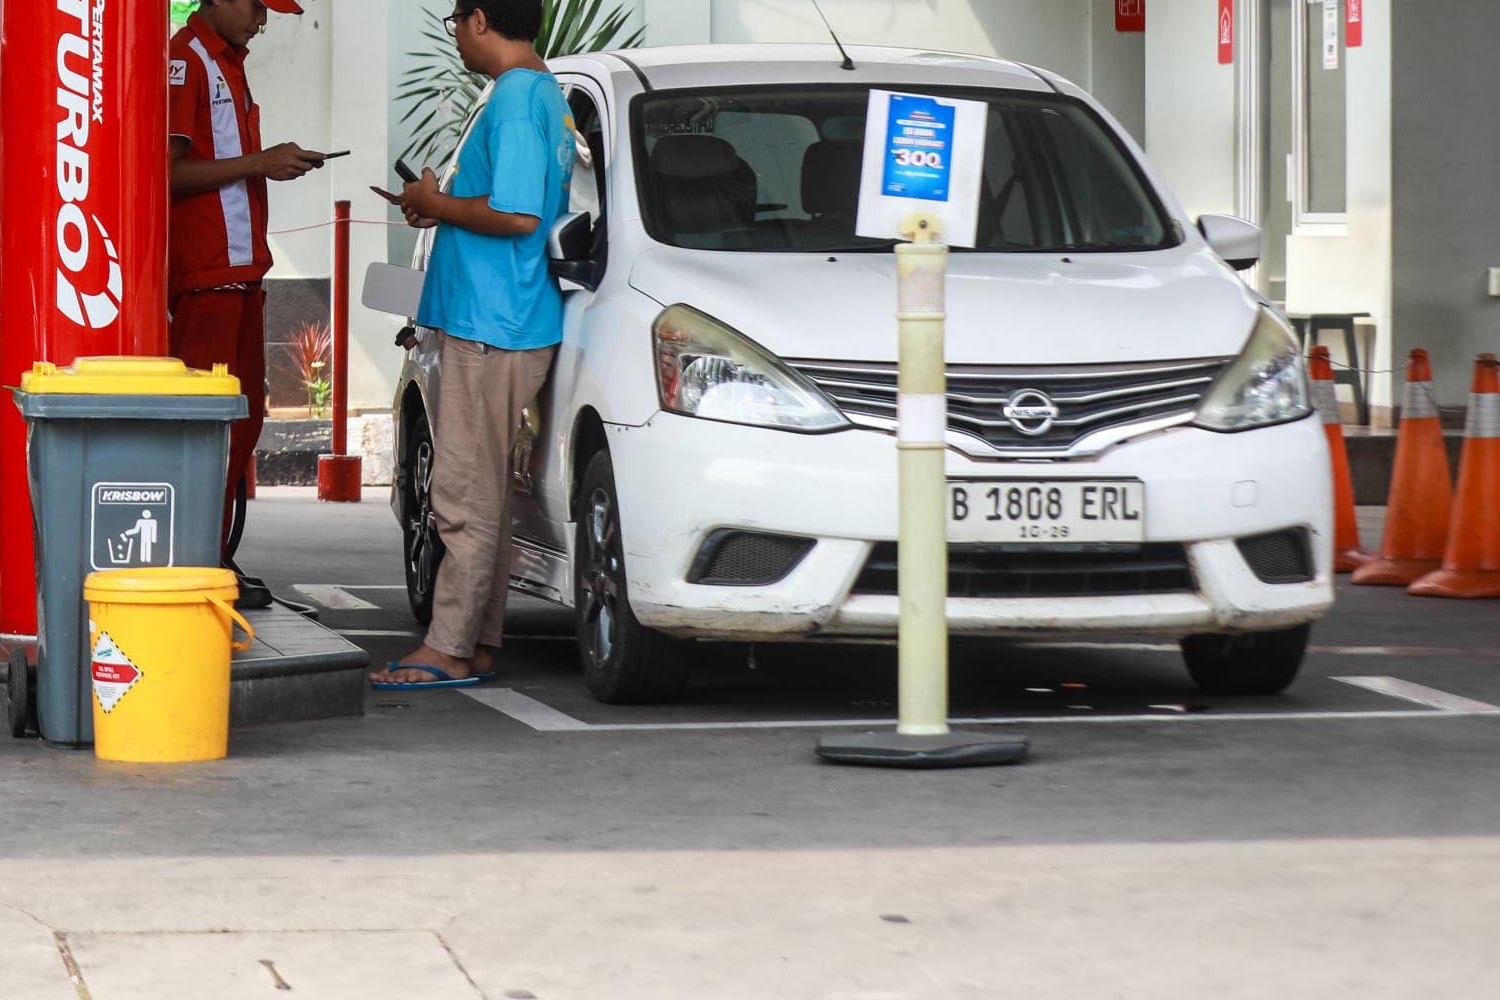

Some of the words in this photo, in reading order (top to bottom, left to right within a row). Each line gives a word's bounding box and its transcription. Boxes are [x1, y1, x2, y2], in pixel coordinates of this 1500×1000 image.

[102, 490, 166, 501] KRISBOW
[952, 487, 969, 521] B
[986, 487, 1063, 521] 1808
[1081, 486, 1139, 521] ERL
